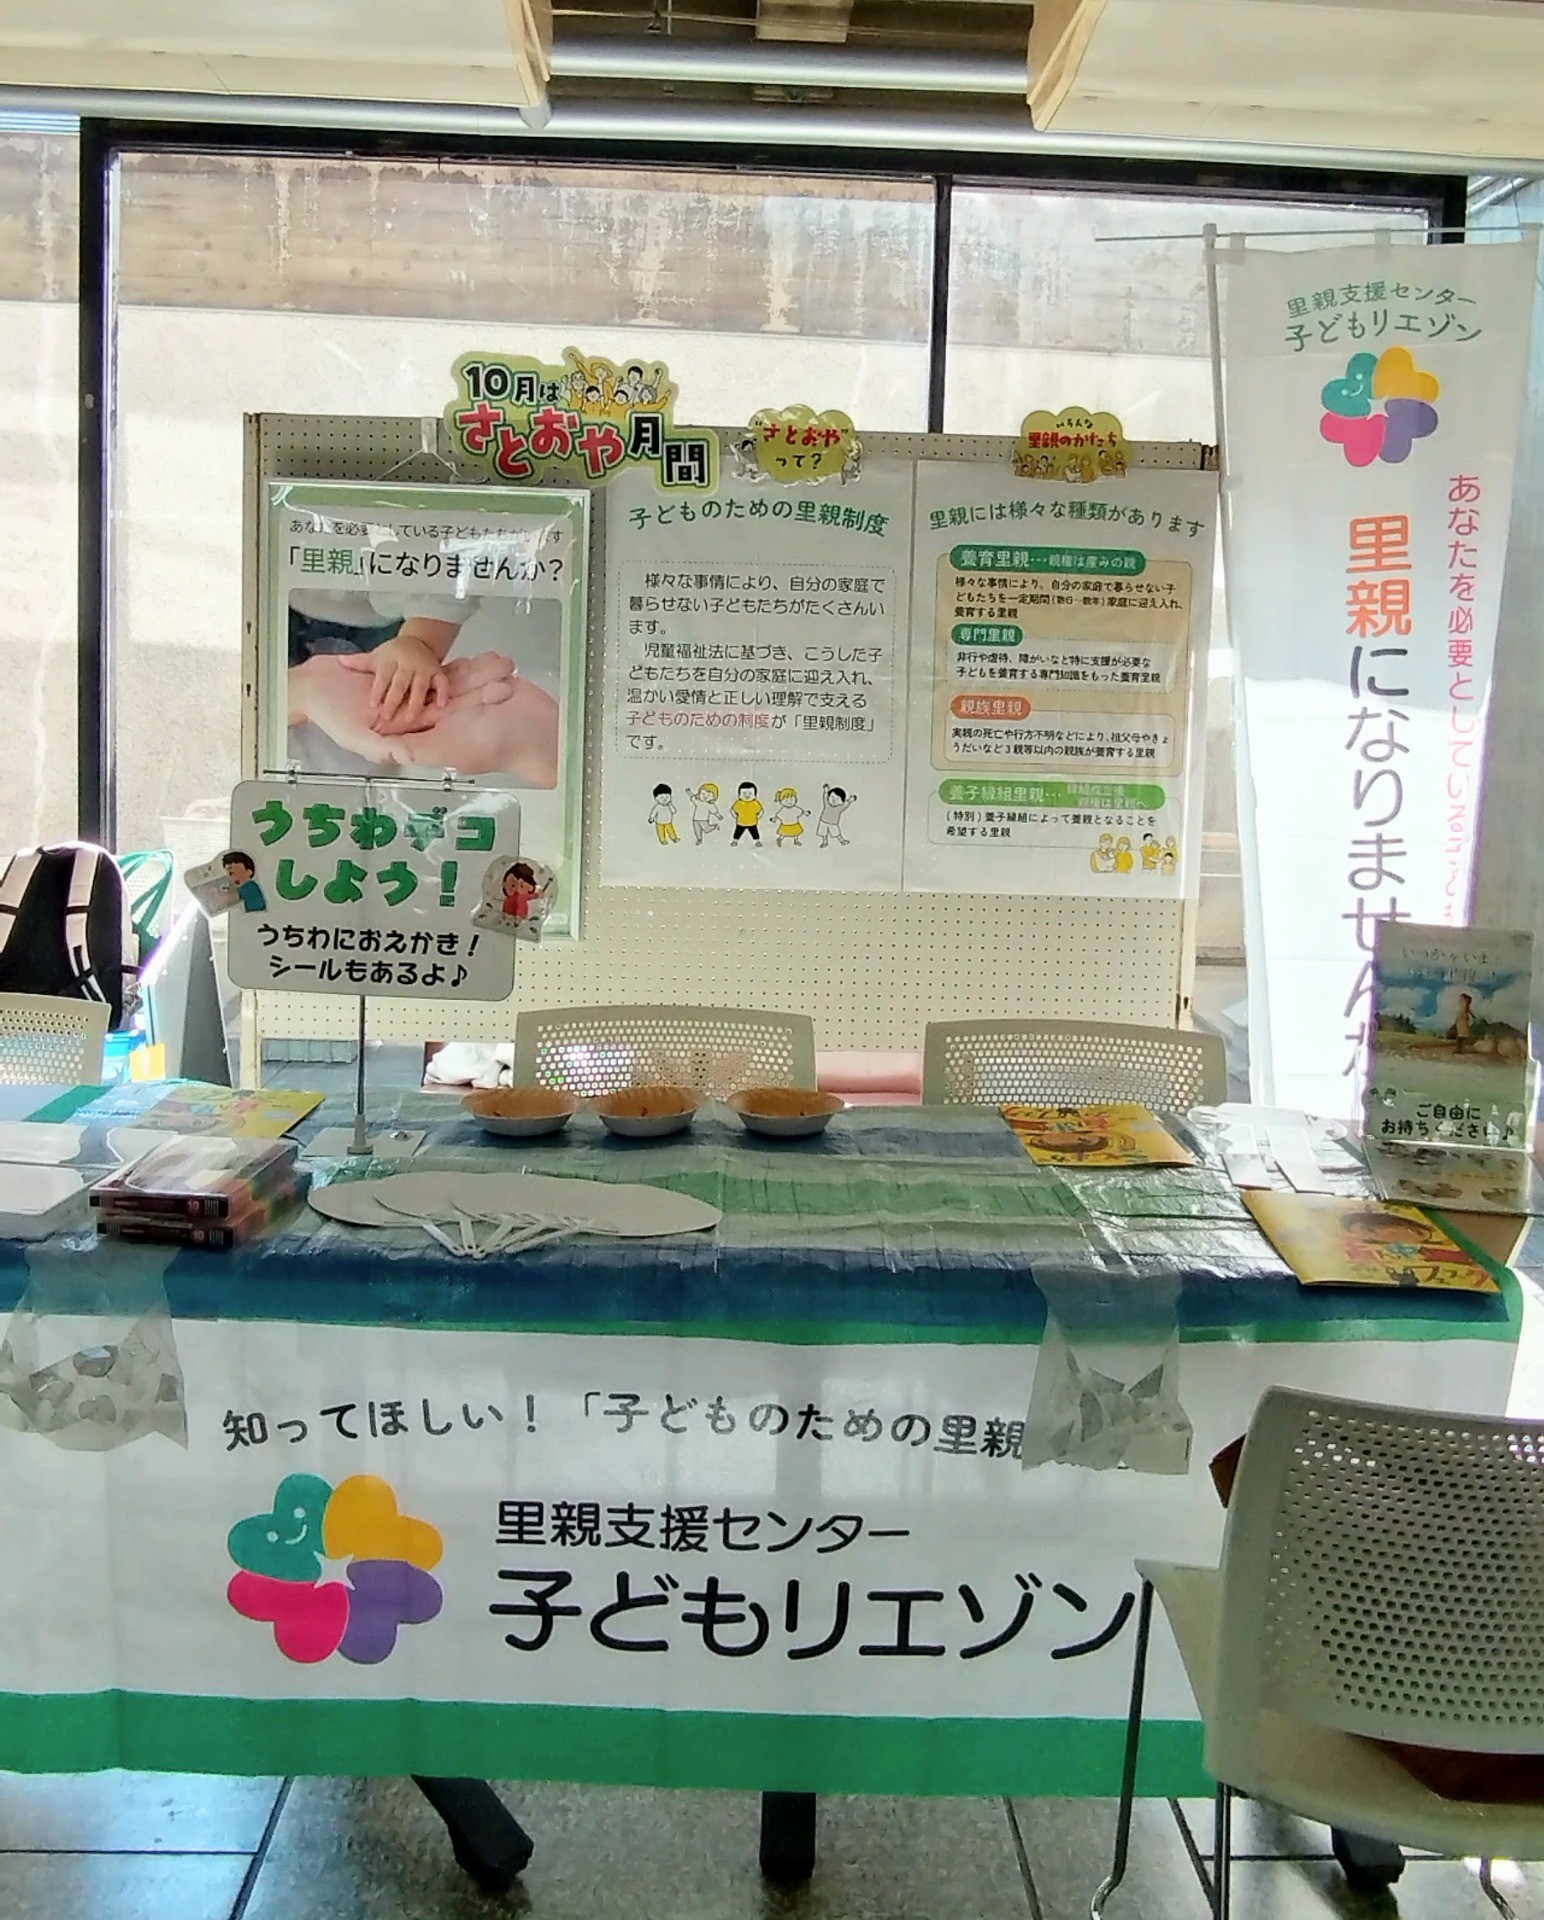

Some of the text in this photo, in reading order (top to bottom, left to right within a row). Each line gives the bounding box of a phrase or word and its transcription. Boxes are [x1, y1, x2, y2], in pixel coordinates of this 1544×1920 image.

[1287, 280, 1477, 319] 里親支援センター
[1284, 308, 1482, 352] 子どもリエゾン
[465, 364, 560, 404] 10月は
[457, 403, 706, 486] さとおや月間
[629, 497, 890, 537] 子どものための里親制度
[929, 500, 1205, 538] 里親には様々な種類があります
[645, 573, 885, 594] 様々な事情により、自分の家庭で
[629, 596, 885, 616] 暮らせない子どもたちがたくさんい
[629, 619, 666, 635] ます。
[958, 627, 1016, 643] 専門里親
[644, 643, 883, 663] 児童福祉法に基づき、こうした子
[628, 665, 874, 686] どもたちを自分の家庭に迎え入れ、
[626, 688, 867, 709] 温かい愛情と正しい理解で支える
[960, 700, 1023, 716] 親族里親
[626, 711, 877, 732] 子どものための制度が「里親制度」
[627, 735, 664, 751] です。
[252, 800, 496, 851] うちわデコ
[946, 827, 1011, 839] 希望する里親
[274, 859, 458, 907] しよう！
[257, 923, 480, 958] うちわにおえかき！
[1416, 1103, 1481, 1120] ご自由に
[496, 1500, 910, 1553] 里親支援センター
[489, 1571, 1136, 1660] 子どもリエゾン
